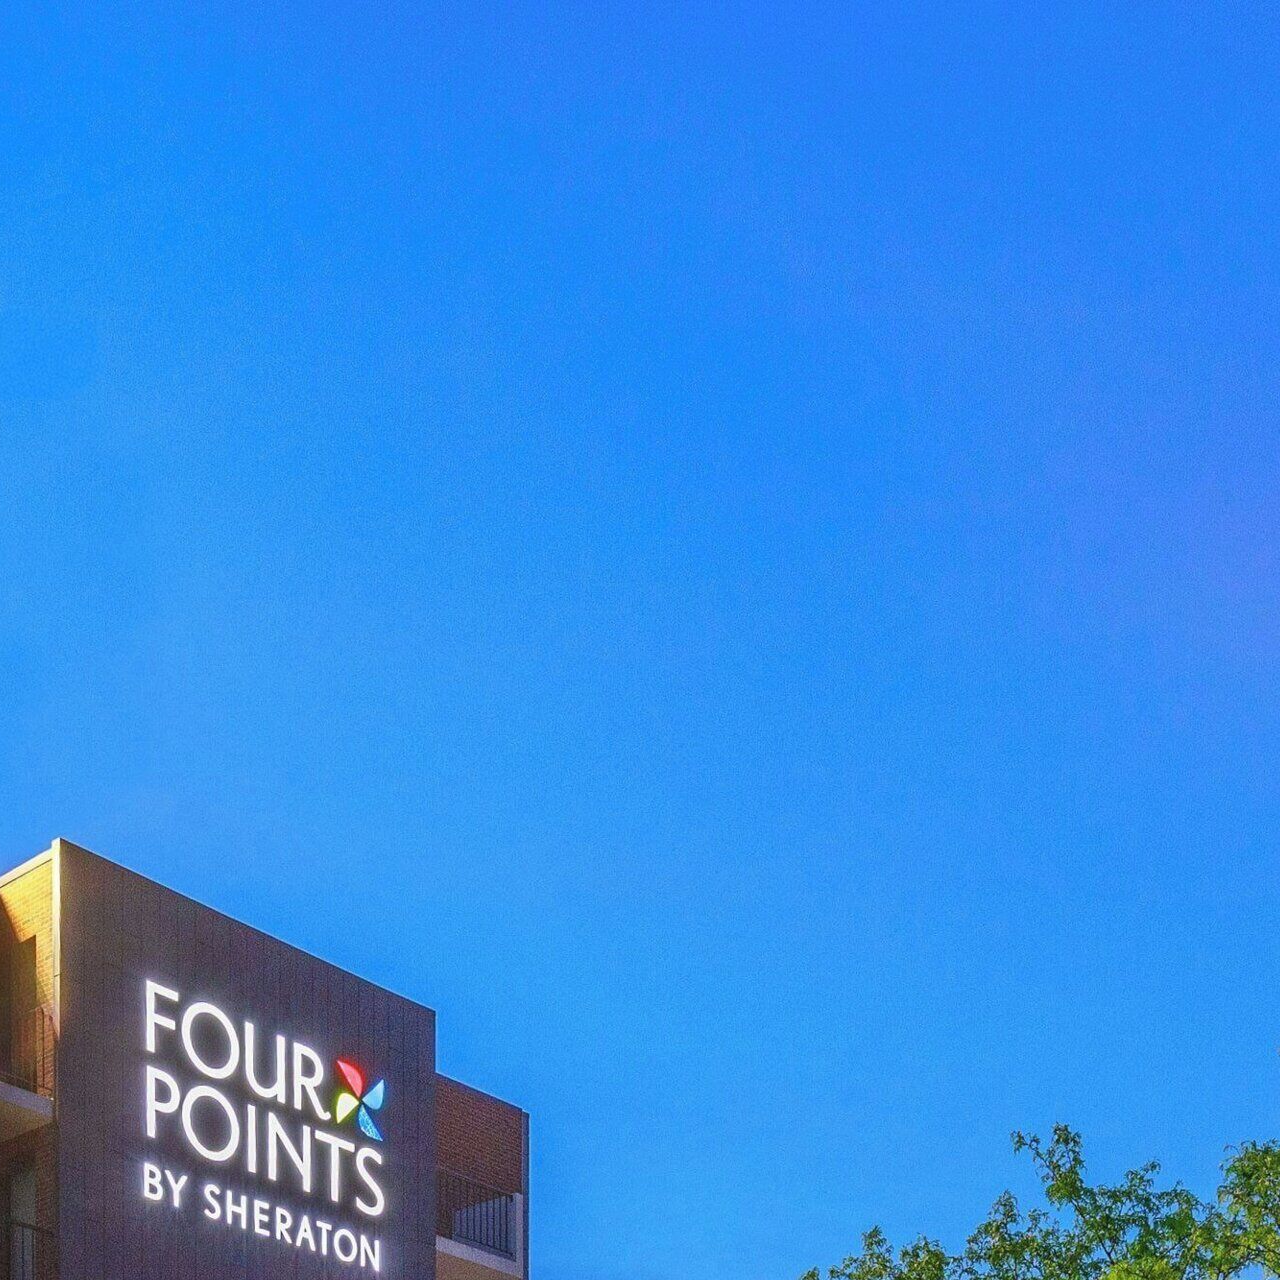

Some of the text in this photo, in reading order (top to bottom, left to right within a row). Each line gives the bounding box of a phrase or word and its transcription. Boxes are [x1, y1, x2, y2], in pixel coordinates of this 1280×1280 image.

[145, 980, 332, 1121] FOUR
[145, 1064, 386, 1217] POINTS
[144, 1161, 381, 1272] BY SHERATON
